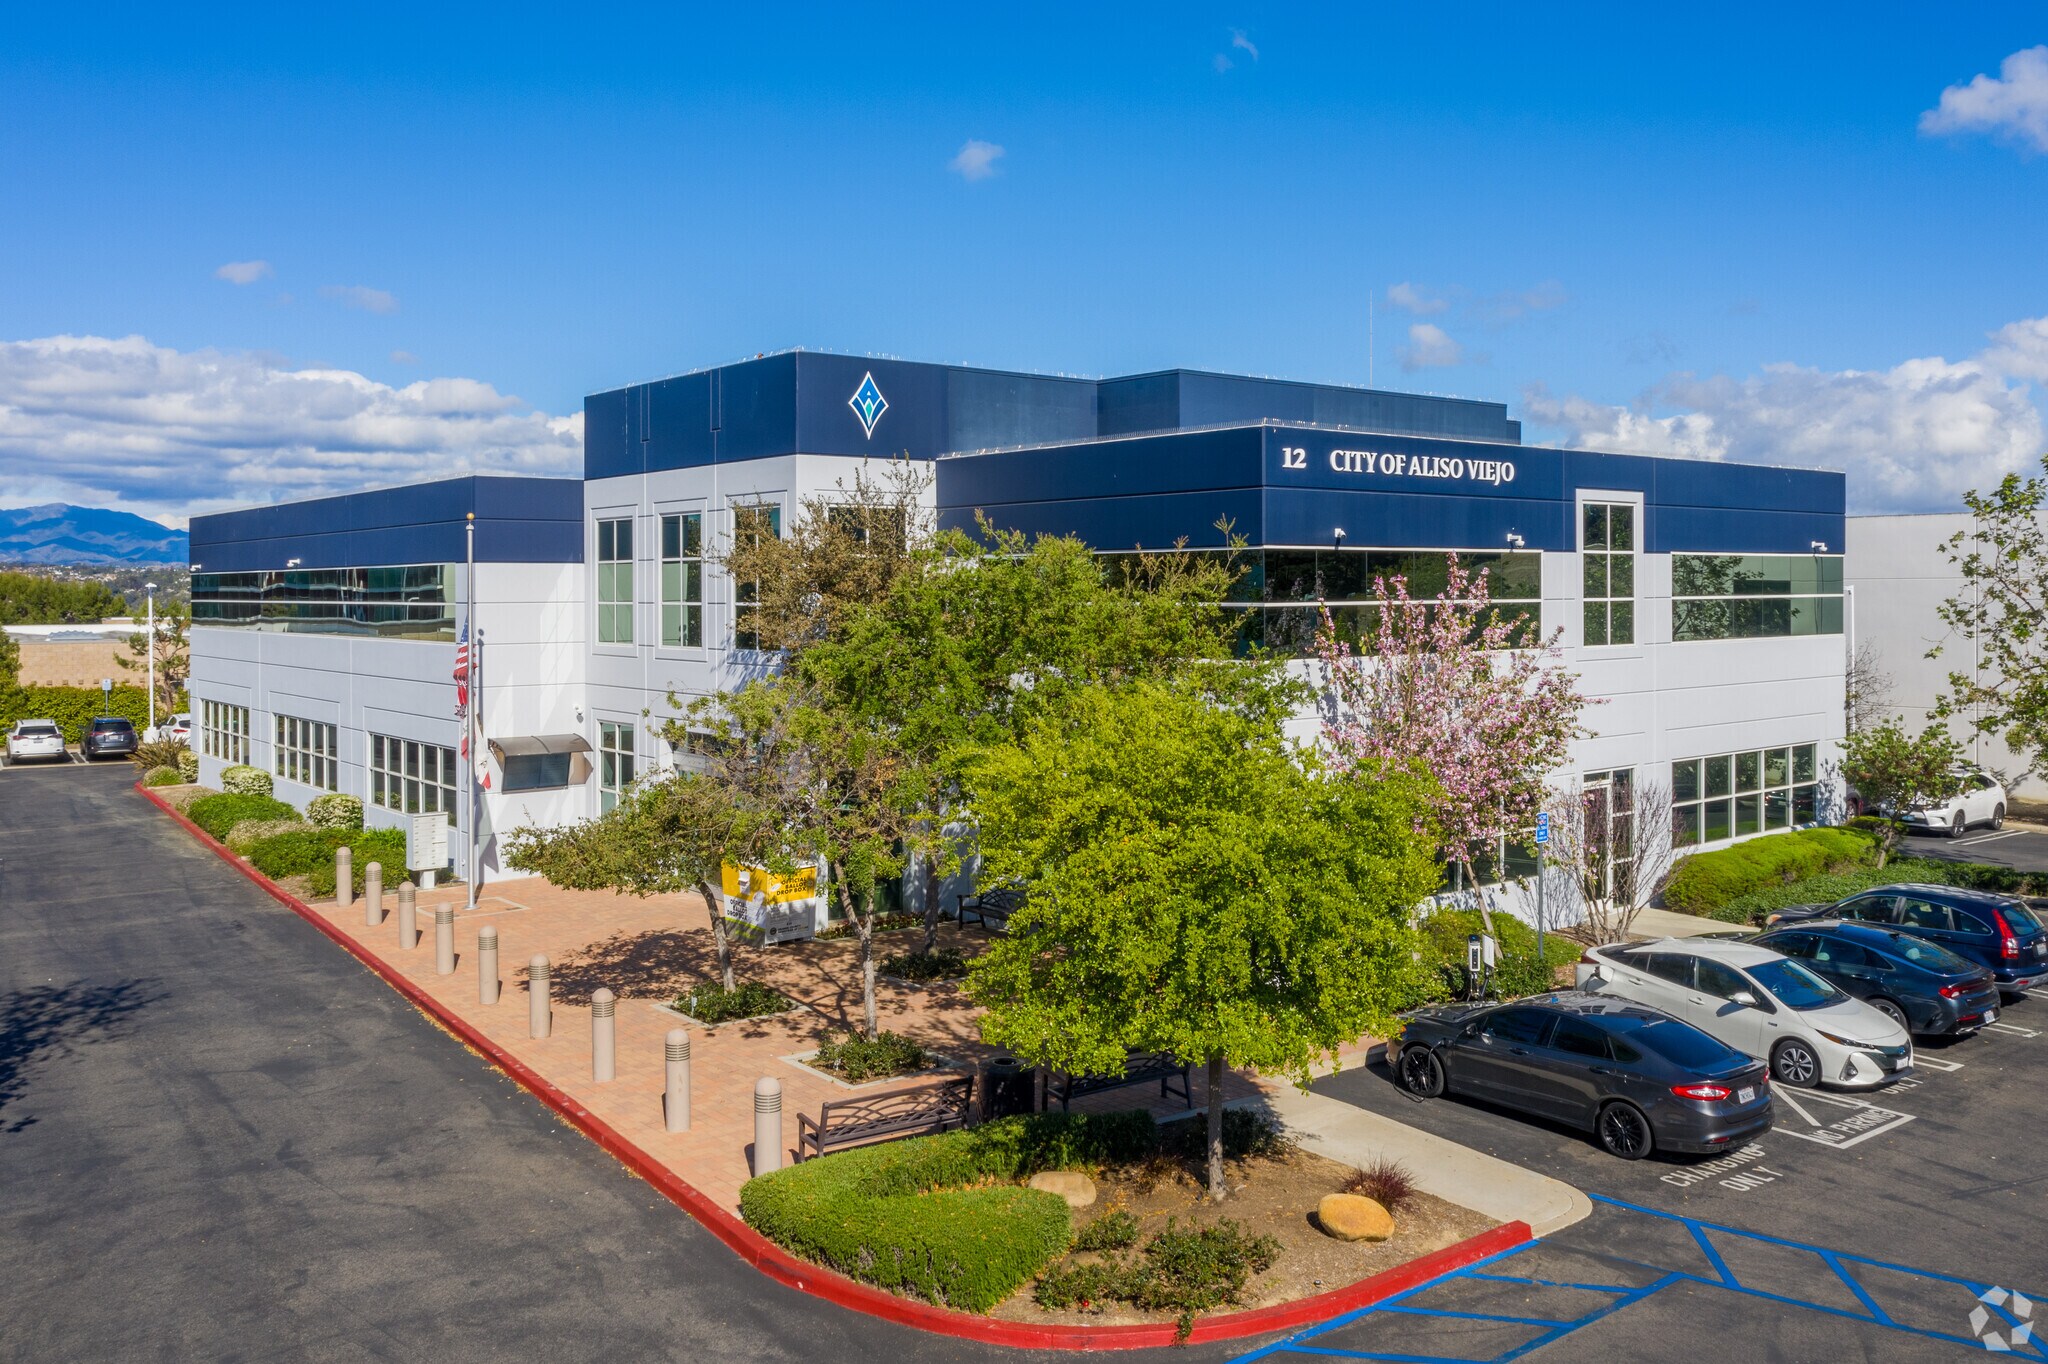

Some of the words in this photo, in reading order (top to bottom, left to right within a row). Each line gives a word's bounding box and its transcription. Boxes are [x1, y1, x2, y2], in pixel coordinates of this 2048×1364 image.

[1282, 447, 1306, 469] 12
[1329, 449, 1377, 473] CITY
[1379, 453, 1406, 475] OF
[1408, 455, 1464, 479] ALISO
[1465, 459, 1515, 486] VIEJO
[1829, 1108, 1897, 1134] PARKING
[1660, 1142, 1767, 1188] CHARGING
[1718, 1165, 1784, 1192] ONLY
